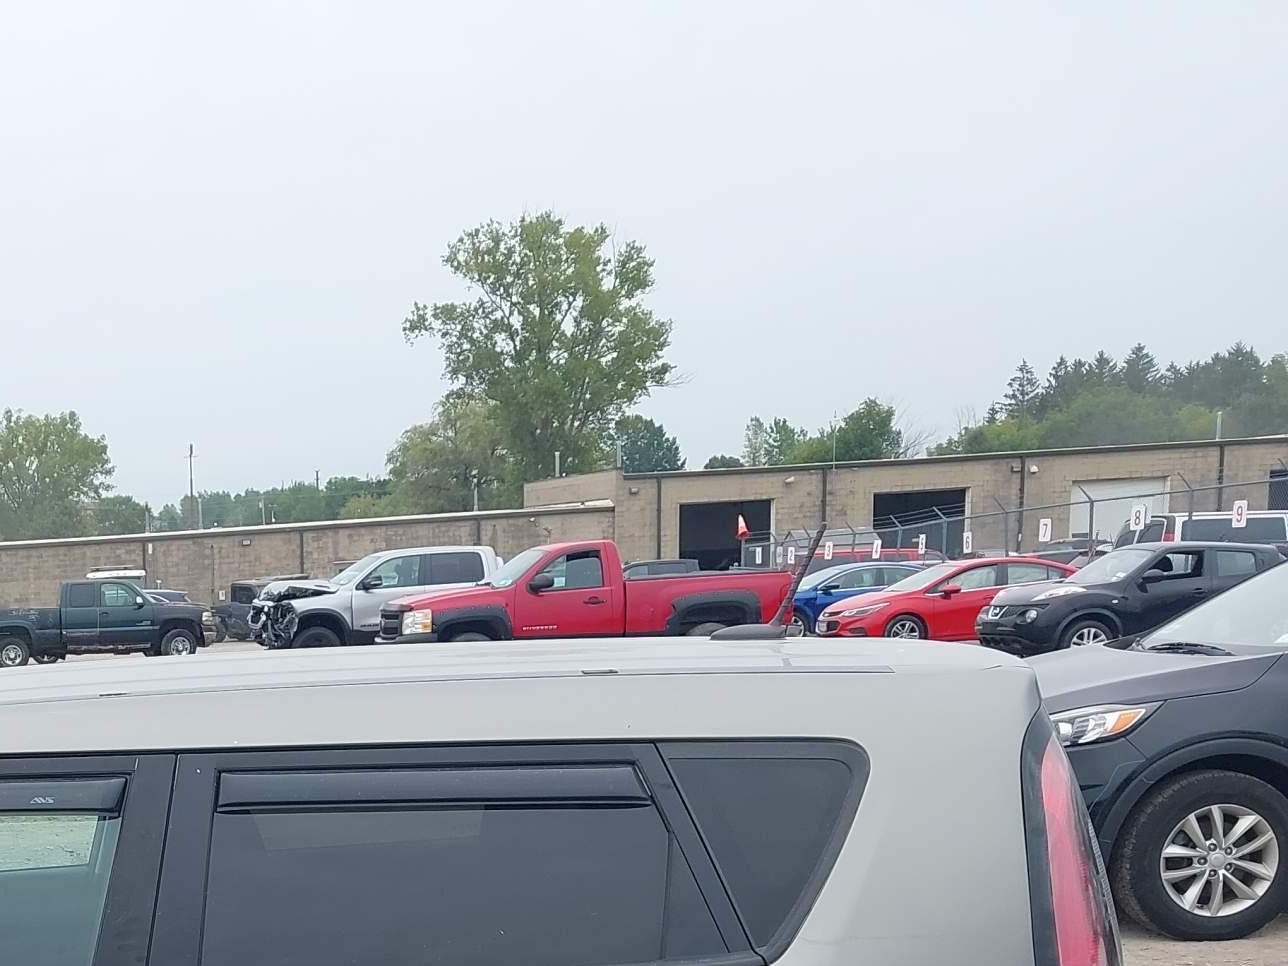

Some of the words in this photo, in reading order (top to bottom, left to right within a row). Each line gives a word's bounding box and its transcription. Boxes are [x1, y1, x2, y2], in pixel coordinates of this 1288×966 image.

[1134, 509, 1142, 526] 8
[1236, 505, 1244, 523] 9
[1041, 523, 1049, 538] 7
[30, 796, 56, 804] AVS
